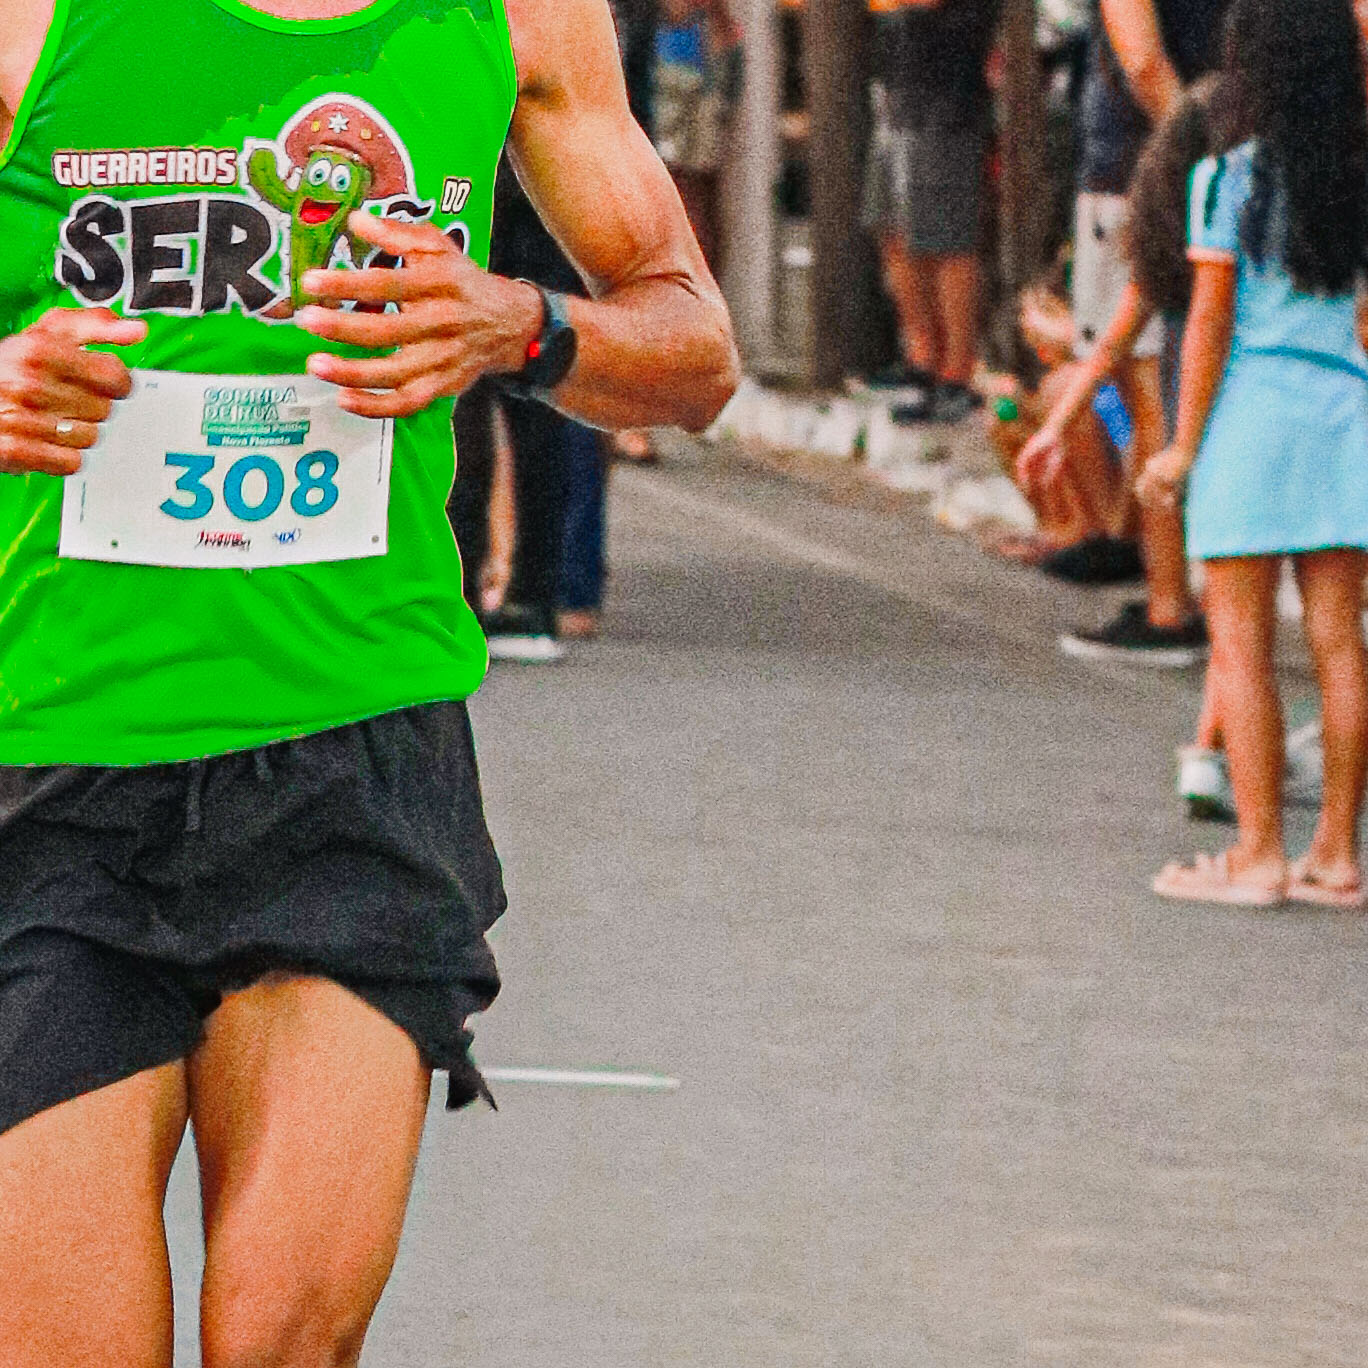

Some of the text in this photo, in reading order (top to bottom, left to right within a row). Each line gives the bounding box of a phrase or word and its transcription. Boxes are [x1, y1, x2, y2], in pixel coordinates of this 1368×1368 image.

[53, 148, 473, 215] GUERREIROS DO
[160, 449, 340, 522] 308
